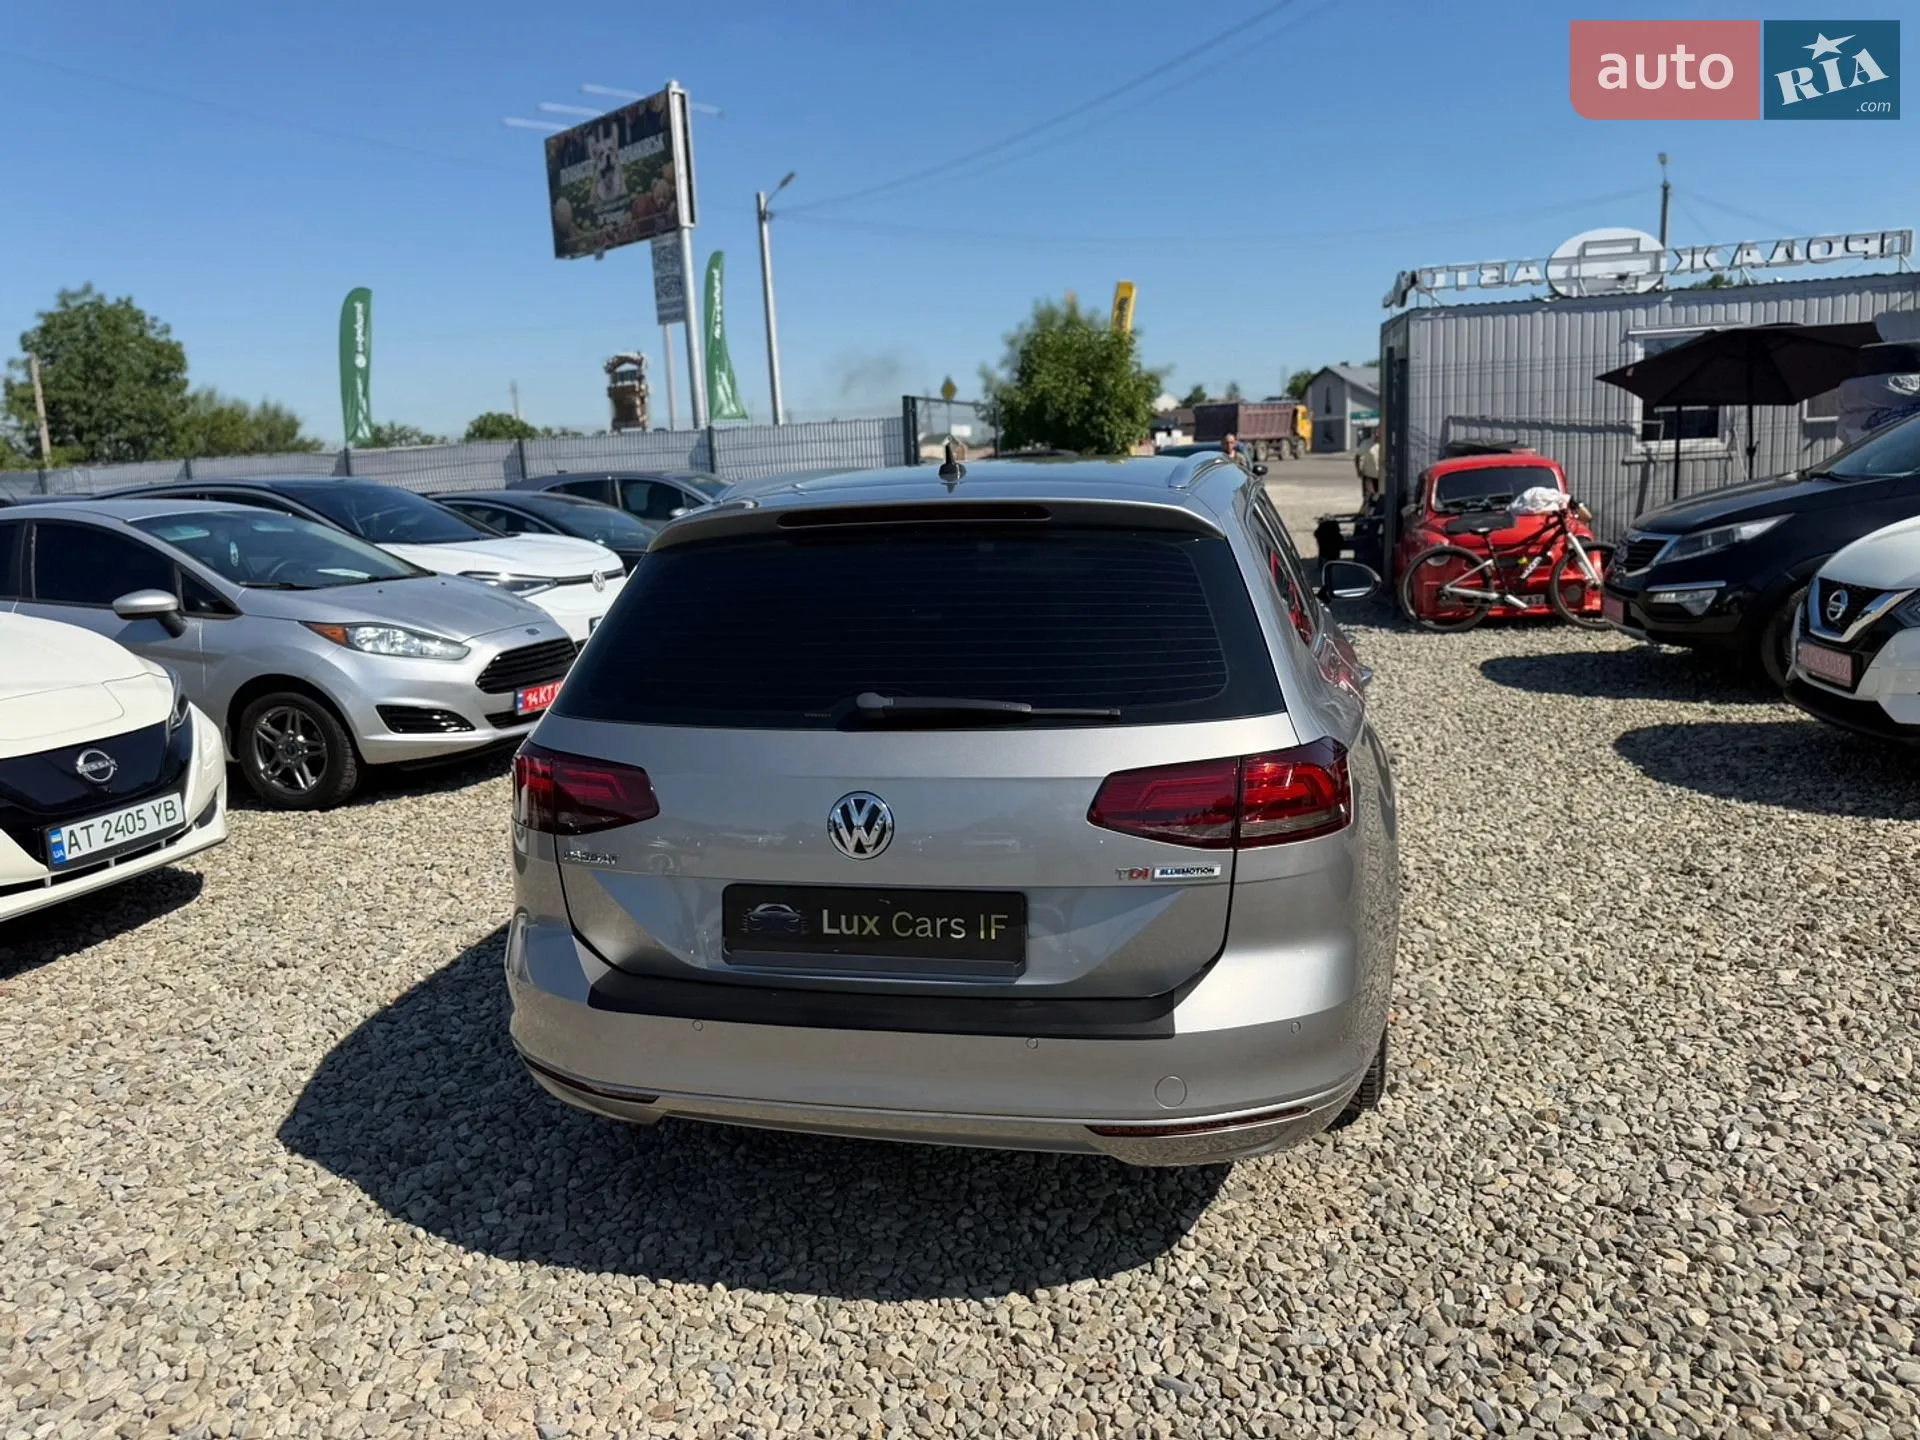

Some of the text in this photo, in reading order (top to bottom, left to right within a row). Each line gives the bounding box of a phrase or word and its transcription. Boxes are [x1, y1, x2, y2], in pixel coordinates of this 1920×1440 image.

[68, 799, 177, 855] AT 2405 YB
[1115, 866, 1150, 881] TDI
[822, 908, 1009, 941] Lux Cars IF
